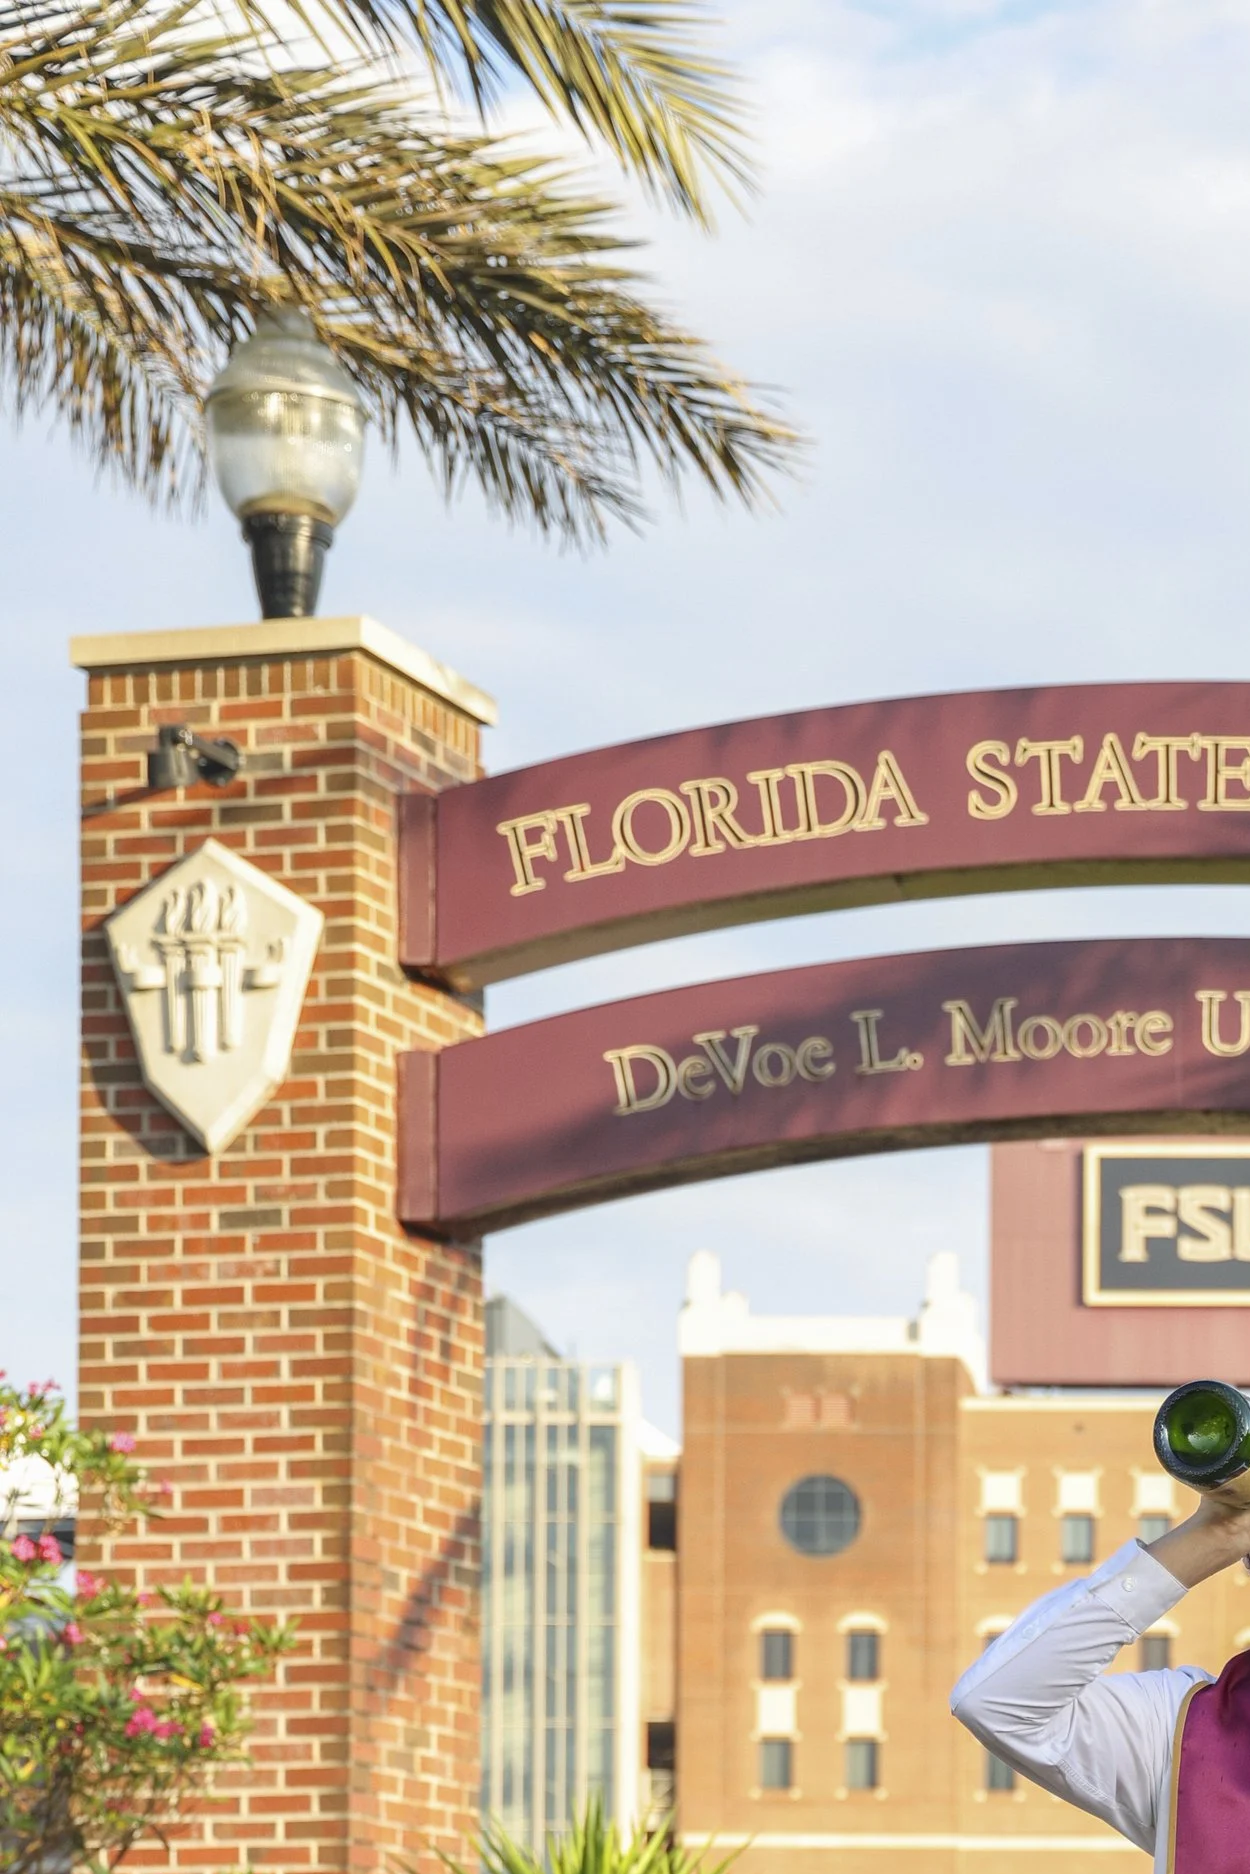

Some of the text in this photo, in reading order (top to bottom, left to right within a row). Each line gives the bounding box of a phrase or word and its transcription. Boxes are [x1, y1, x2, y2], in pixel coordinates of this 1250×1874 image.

[497, 751, 929, 897] FLORIDA
[602, 1026, 835, 1116] DeVoe
[850, 1010, 923, 1075] L.
[942, 998, 1174, 1068] Moore
